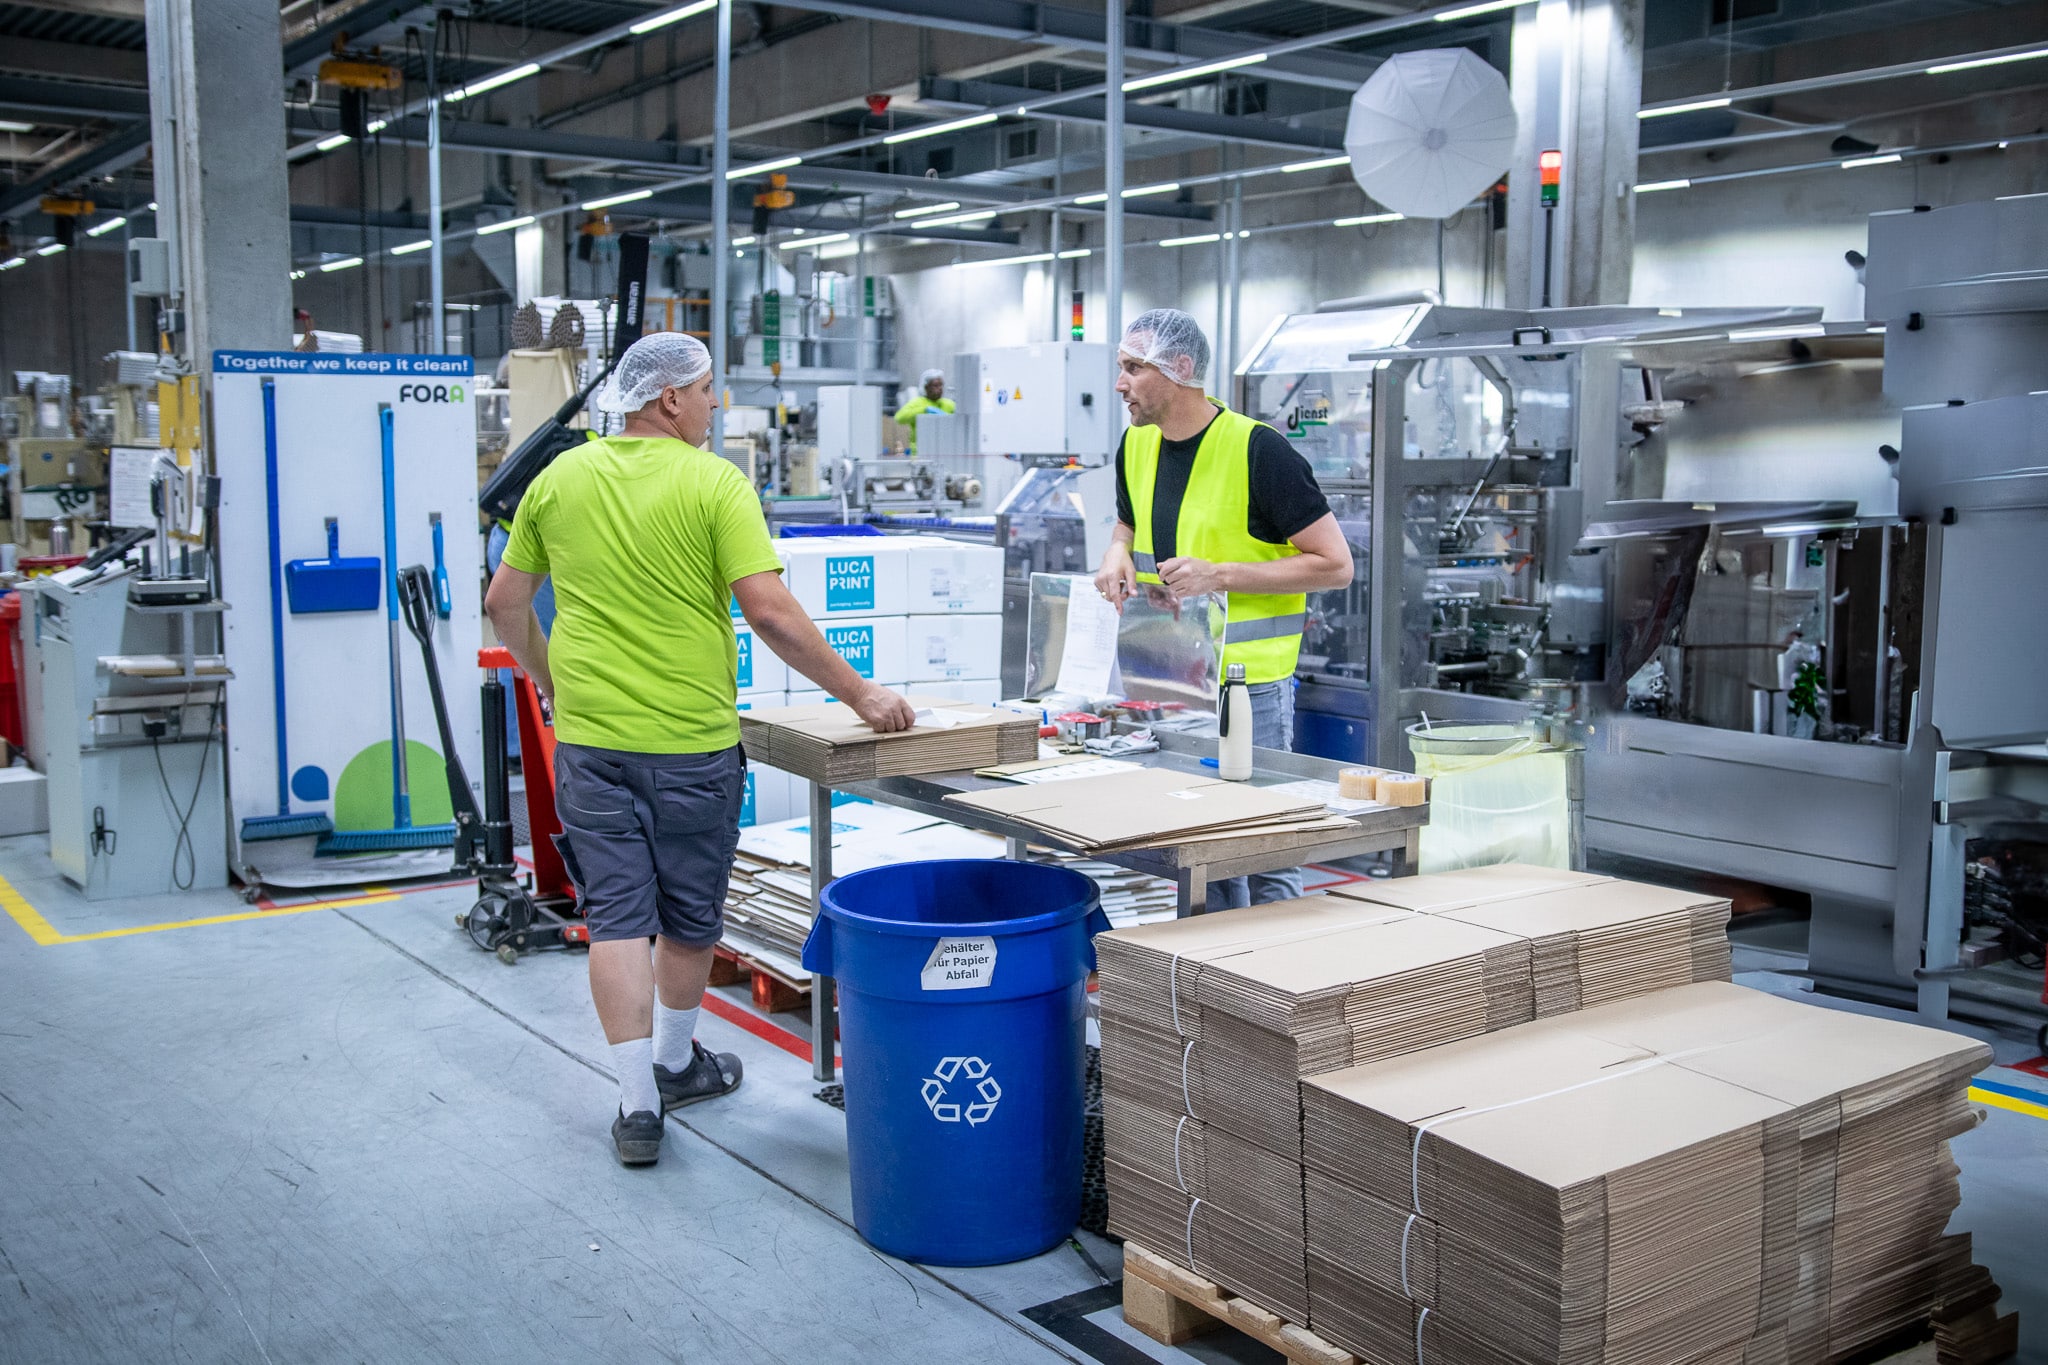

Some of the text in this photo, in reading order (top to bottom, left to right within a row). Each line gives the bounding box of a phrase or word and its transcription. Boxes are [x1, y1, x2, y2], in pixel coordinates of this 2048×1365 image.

[218, 354, 468, 373] Together we keep it clean!
[400, 384, 464, 403] FORA
[829, 560, 871, 575] LUCA
[829, 575, 871, 590] PRINT
[829, 630, 870, 645] LUCA
[944, 943, 985, 954] ehälter
[953, 955, 990, 968] Papier
[945, 968, 979, 980] Abfall
